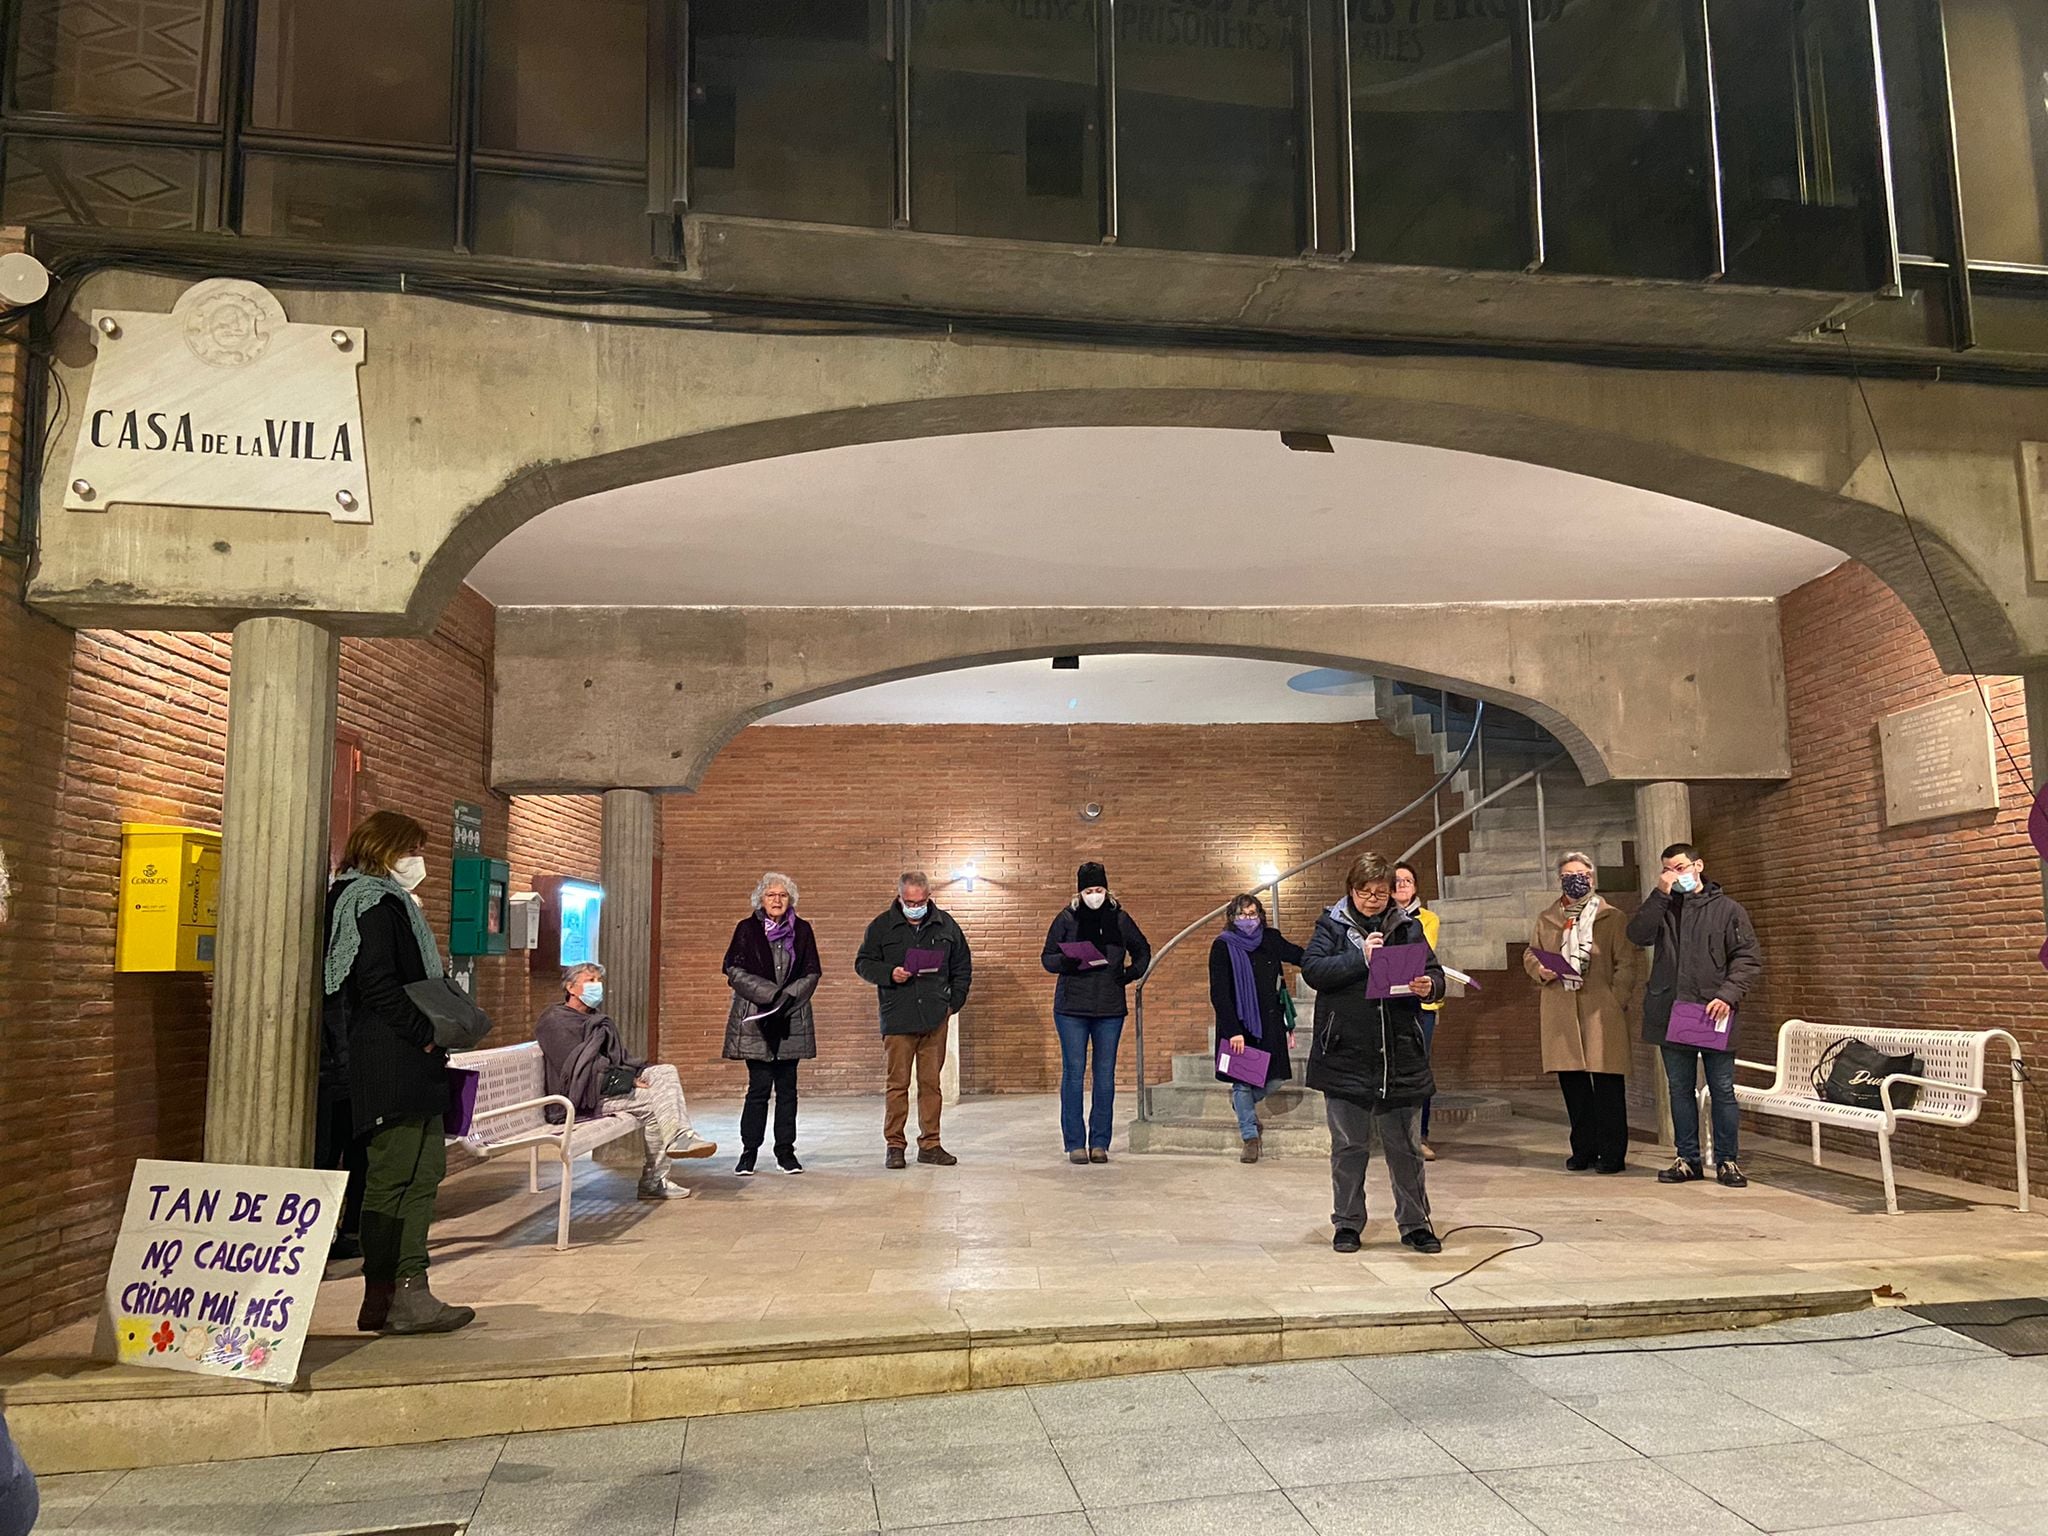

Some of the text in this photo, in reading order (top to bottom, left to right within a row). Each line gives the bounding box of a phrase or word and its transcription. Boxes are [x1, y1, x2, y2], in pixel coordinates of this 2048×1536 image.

[90, 408, 353, 462] CASA DE LA VILA
[131, 877, 168, 885] CORREOS
[149, 1185, 221, 1225] TAN
[229, 1191, 268, 1223] DE
[193, 1234, 305, 1275] CALGUÉS
[243, 1289, 294, 1332] MÉS
